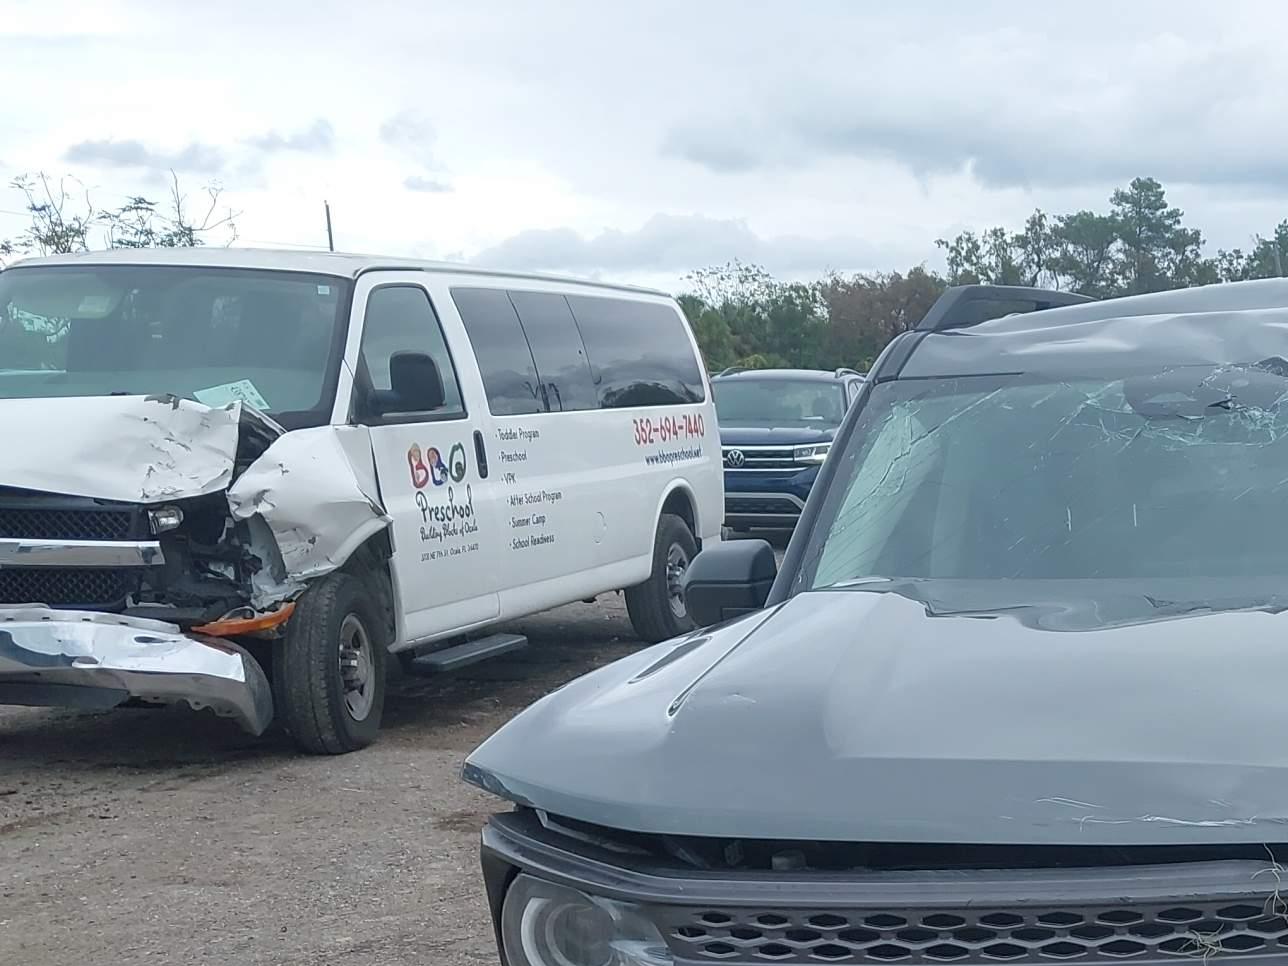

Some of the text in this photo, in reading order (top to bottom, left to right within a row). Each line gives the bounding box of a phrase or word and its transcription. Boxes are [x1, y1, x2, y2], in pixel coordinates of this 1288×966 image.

[498, 427, 540, 442] Toddler Program
[633, 413, 705, 446] 352-694-7440
[501, 450, 527, 462] Preschool
[415, 483, 474, 523] Preschool
[510, 490, 562, 507] After School Program
[511, 513, 546, 529] Summer Camp
[419, 526, 443, 543] Building
[442, 523, 459, 538] Blocks
[512, 533, 555, 550] School Readiness
